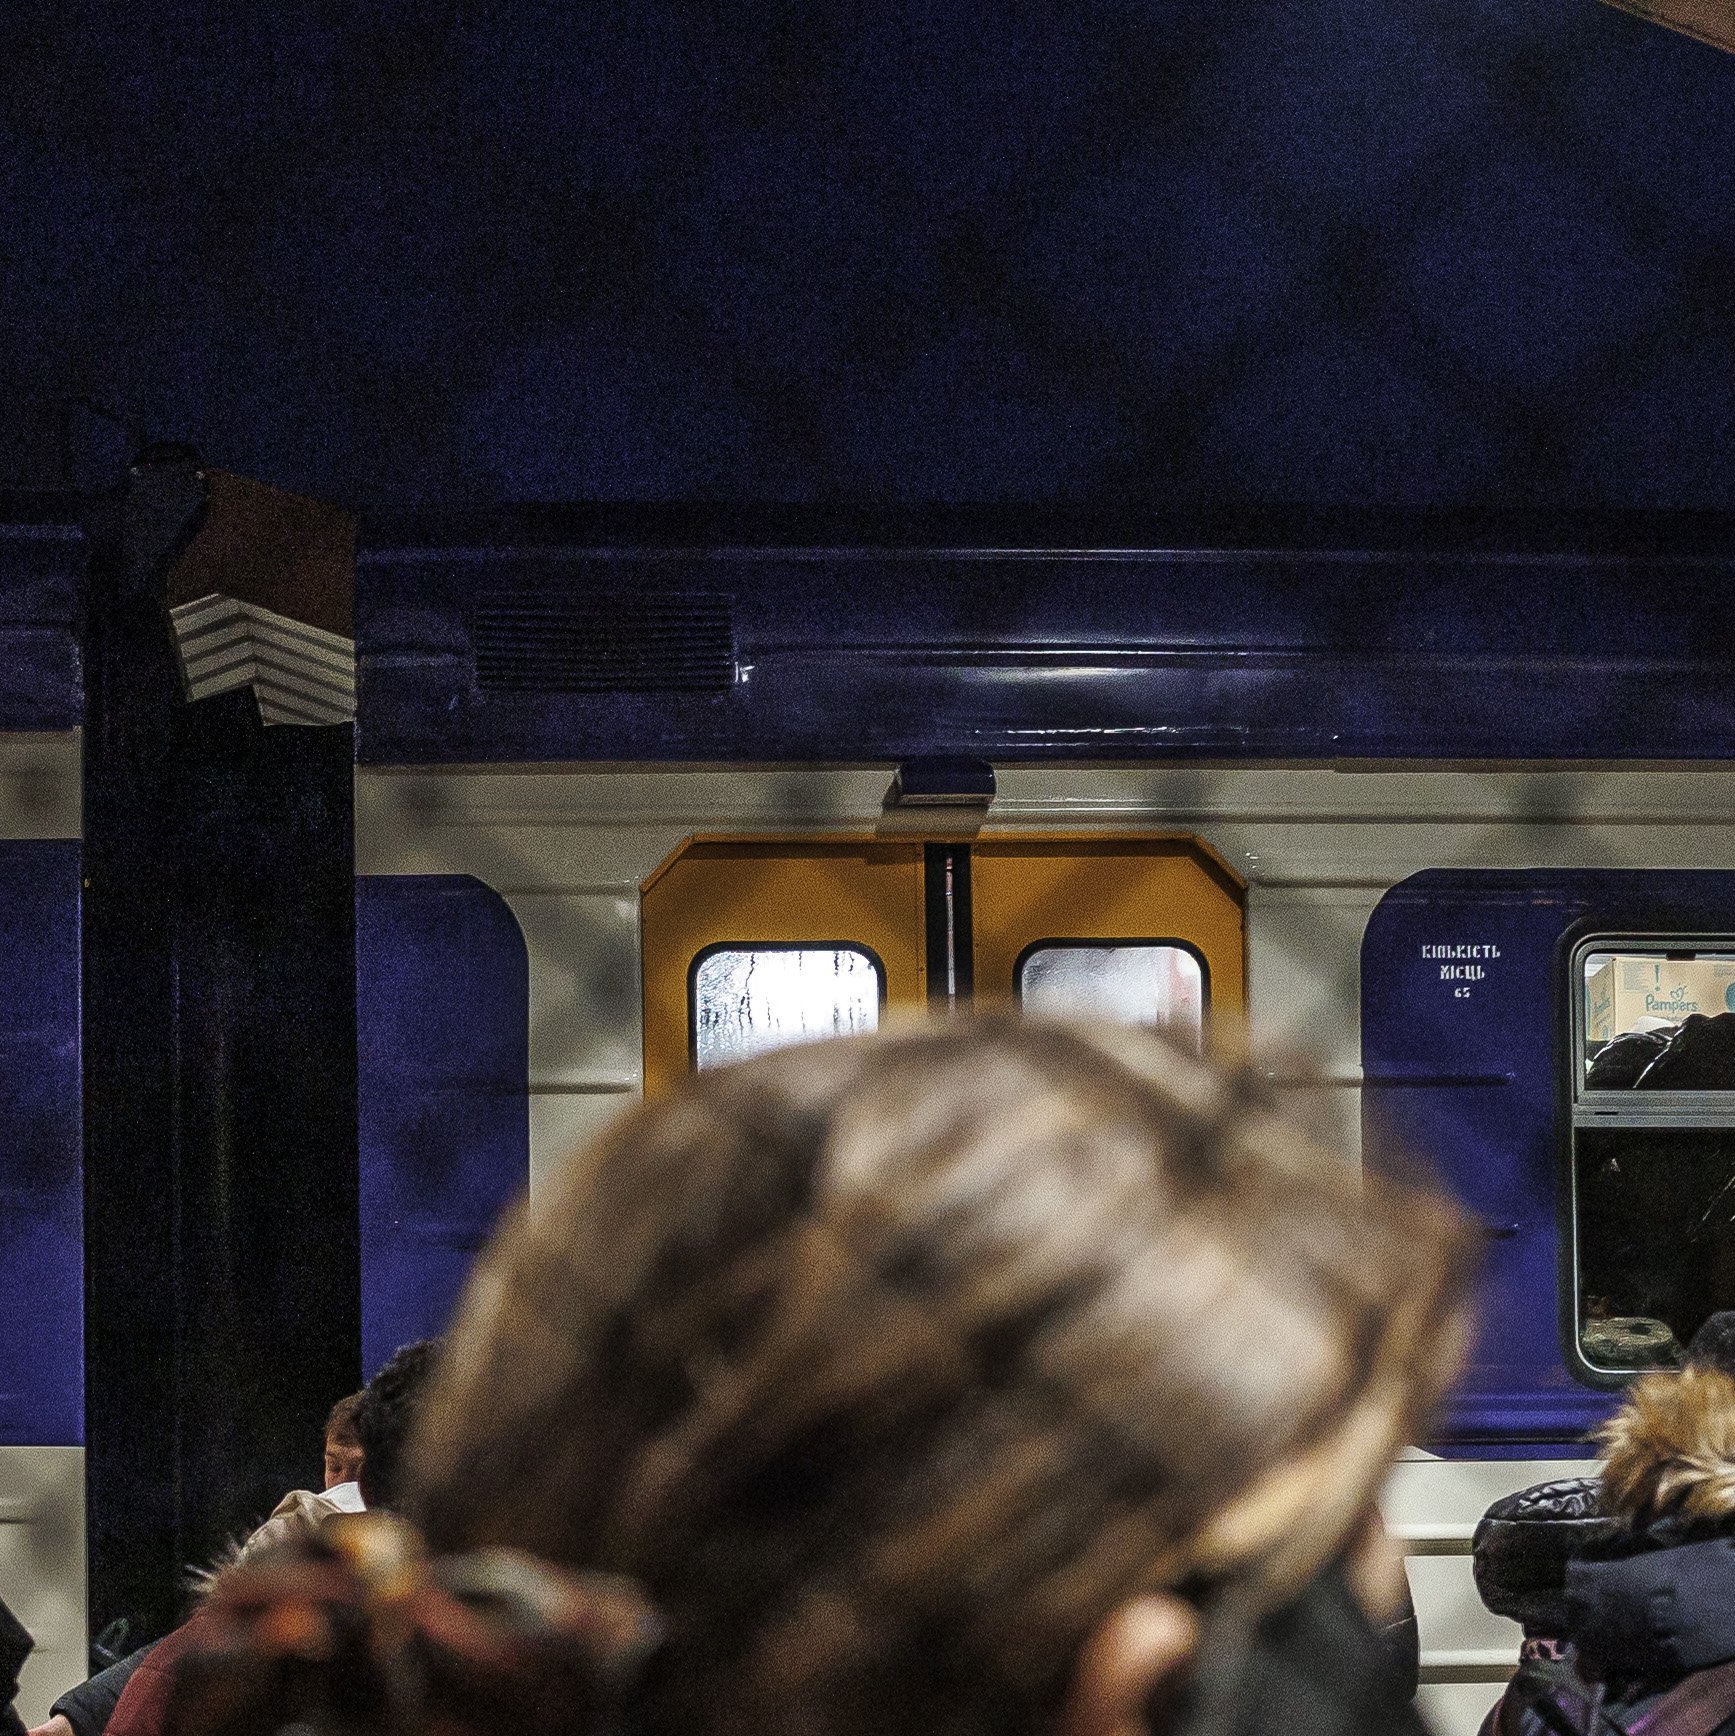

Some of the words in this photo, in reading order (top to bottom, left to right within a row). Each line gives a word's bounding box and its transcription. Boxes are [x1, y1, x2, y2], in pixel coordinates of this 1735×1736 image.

[1422, 945, 1501, 958] КІЛЬКІСТЬ
[1440, 965, 1485, 981] МІСЦЬ
[1454, 987, 1470, 998] 65
[1645, 993, 1699, 1013] Pampers
